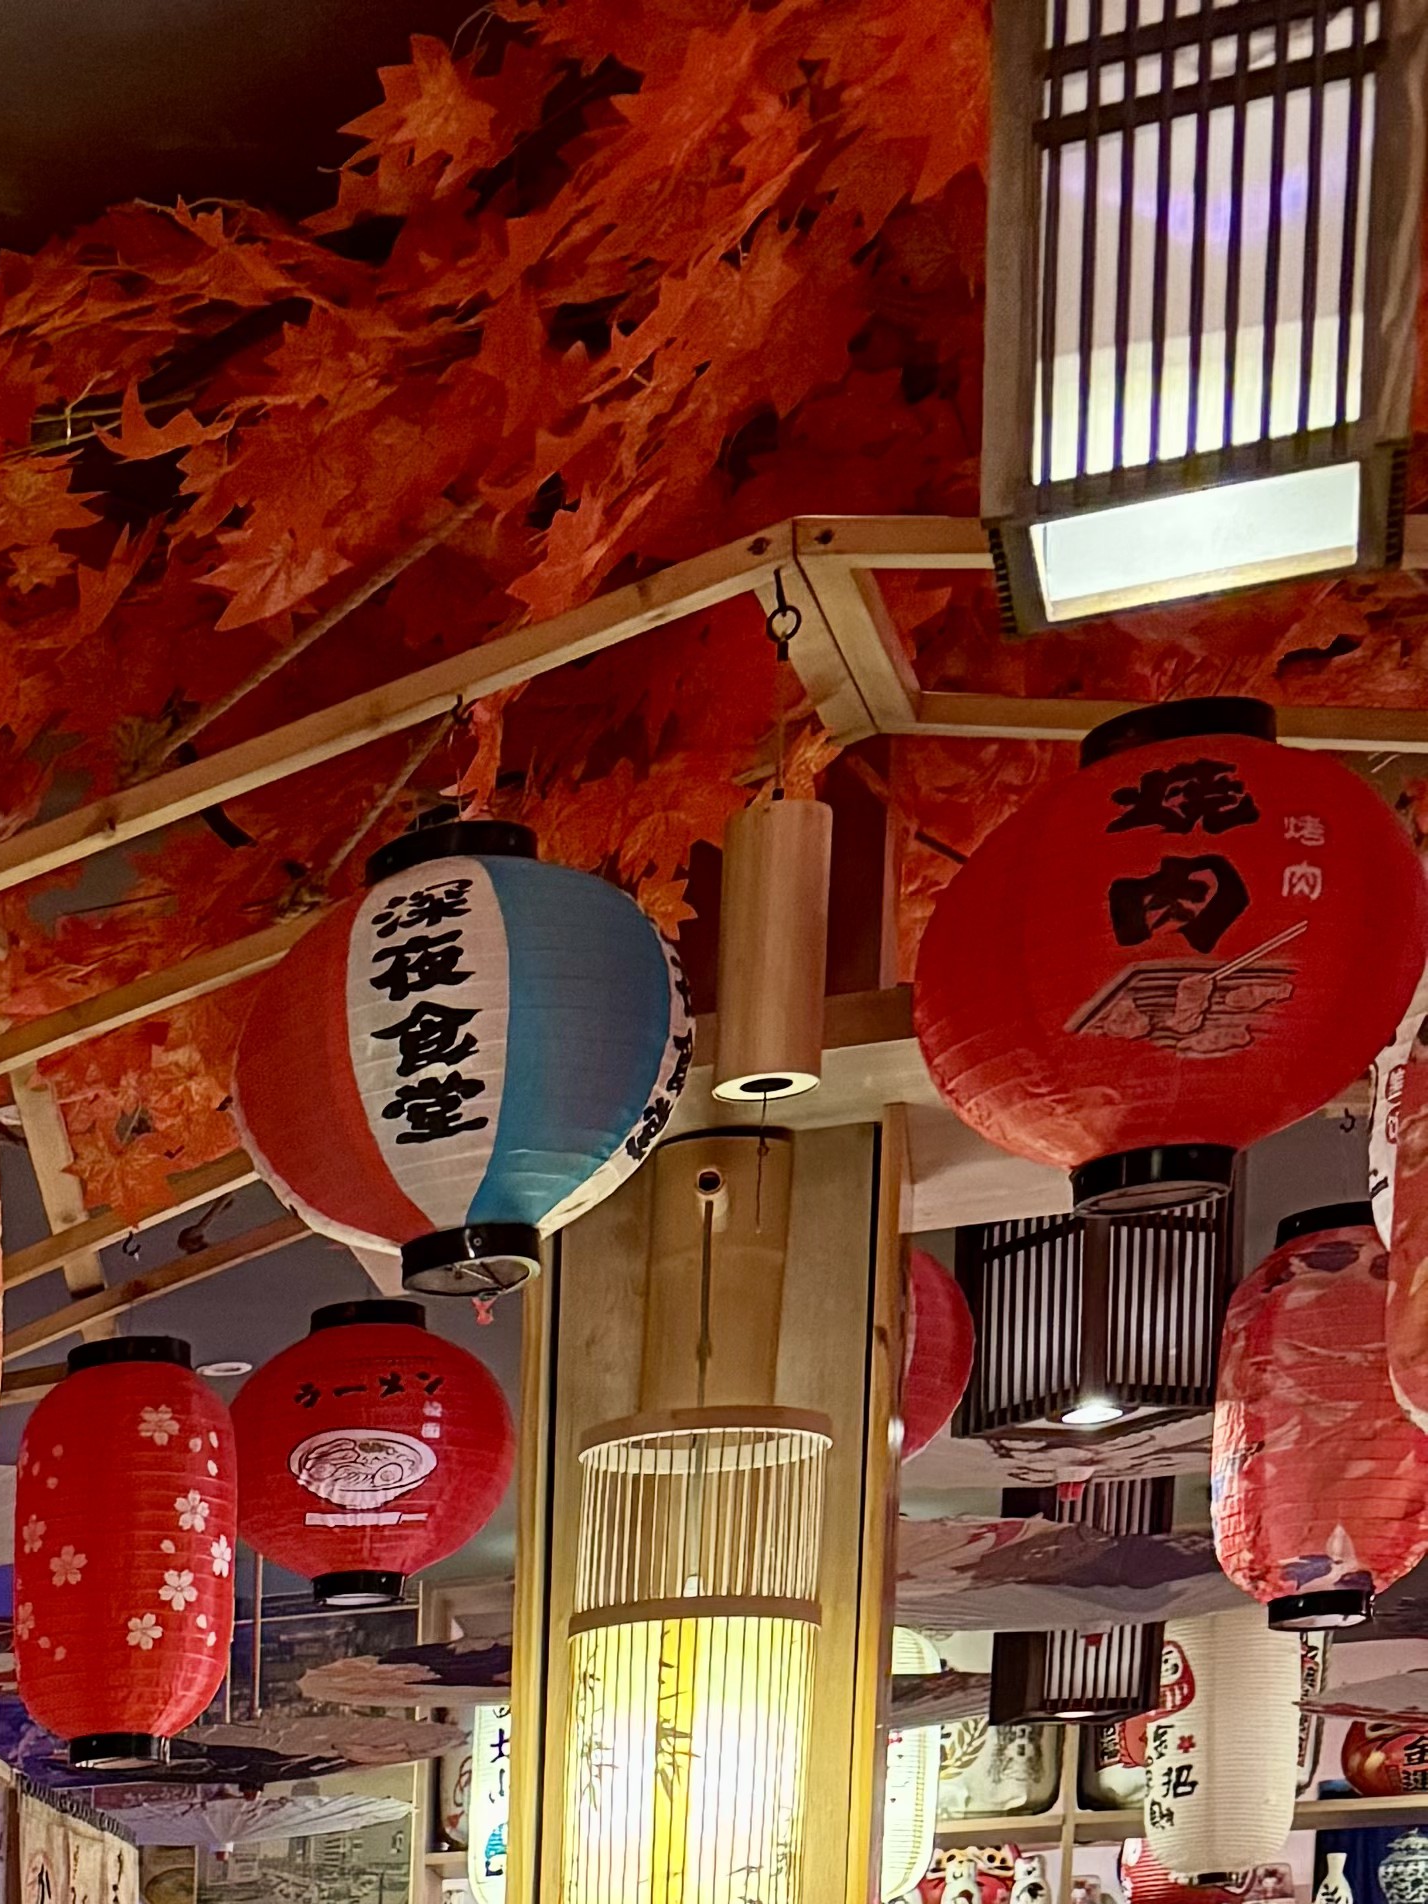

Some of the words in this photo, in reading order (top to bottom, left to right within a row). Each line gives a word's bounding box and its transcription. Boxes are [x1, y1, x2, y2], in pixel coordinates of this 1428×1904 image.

[368, 876, 488, 1146] 深夜食堂
[293, 1371, 444, 1408] ラーメン
